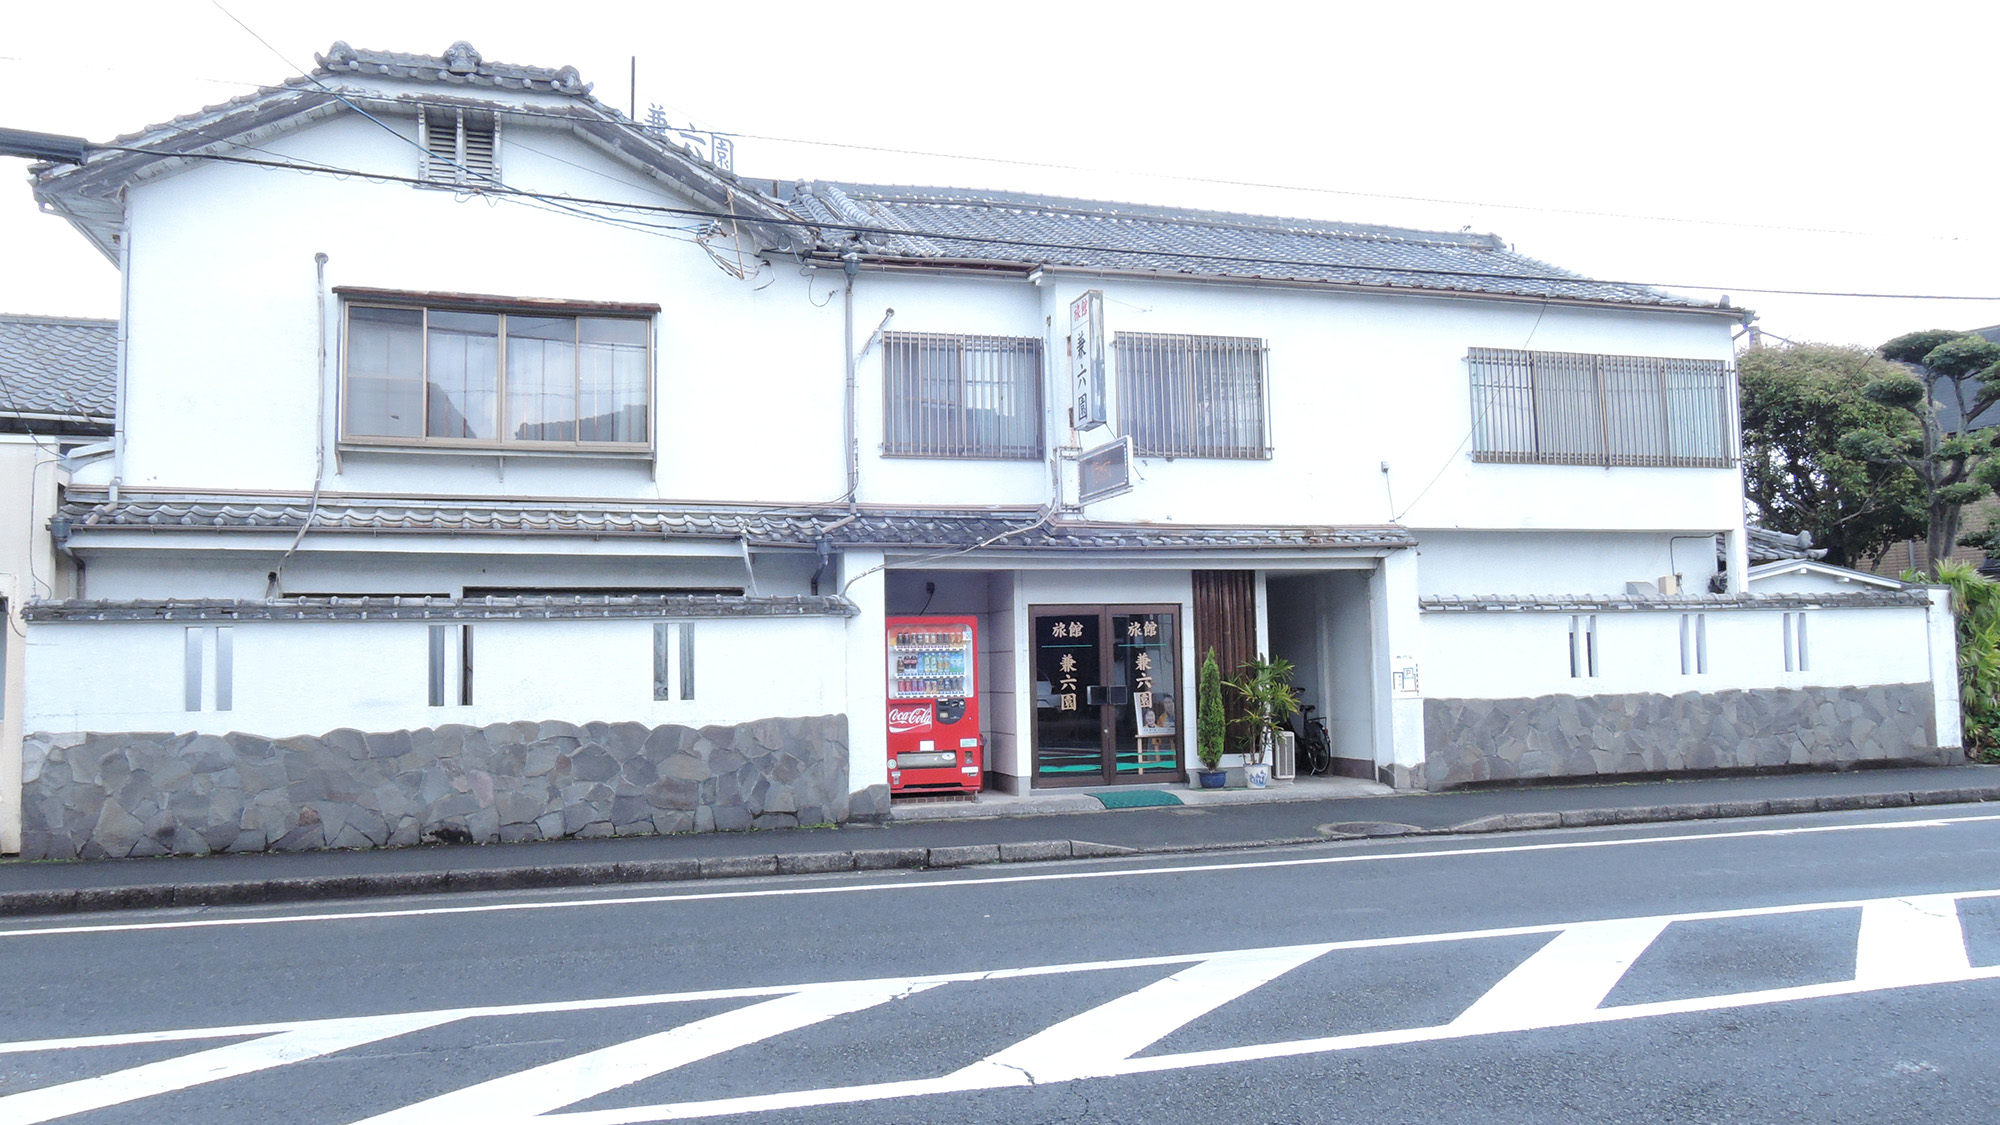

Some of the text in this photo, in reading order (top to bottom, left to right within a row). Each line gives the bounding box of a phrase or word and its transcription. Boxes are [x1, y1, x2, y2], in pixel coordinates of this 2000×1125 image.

[644, 102, 734, 174] 兼六園
[1076, 330, 1088, 421] 兼六園
[1052, 621, 1084, 639] 旅館
[1127, 620, 1158, 638] 旅館
[1059, 653, 1078, 712] 兼六園
[1135, 652, 1153, 709] 兼六園
[888, 707, 931, 724] Coca-Cola
